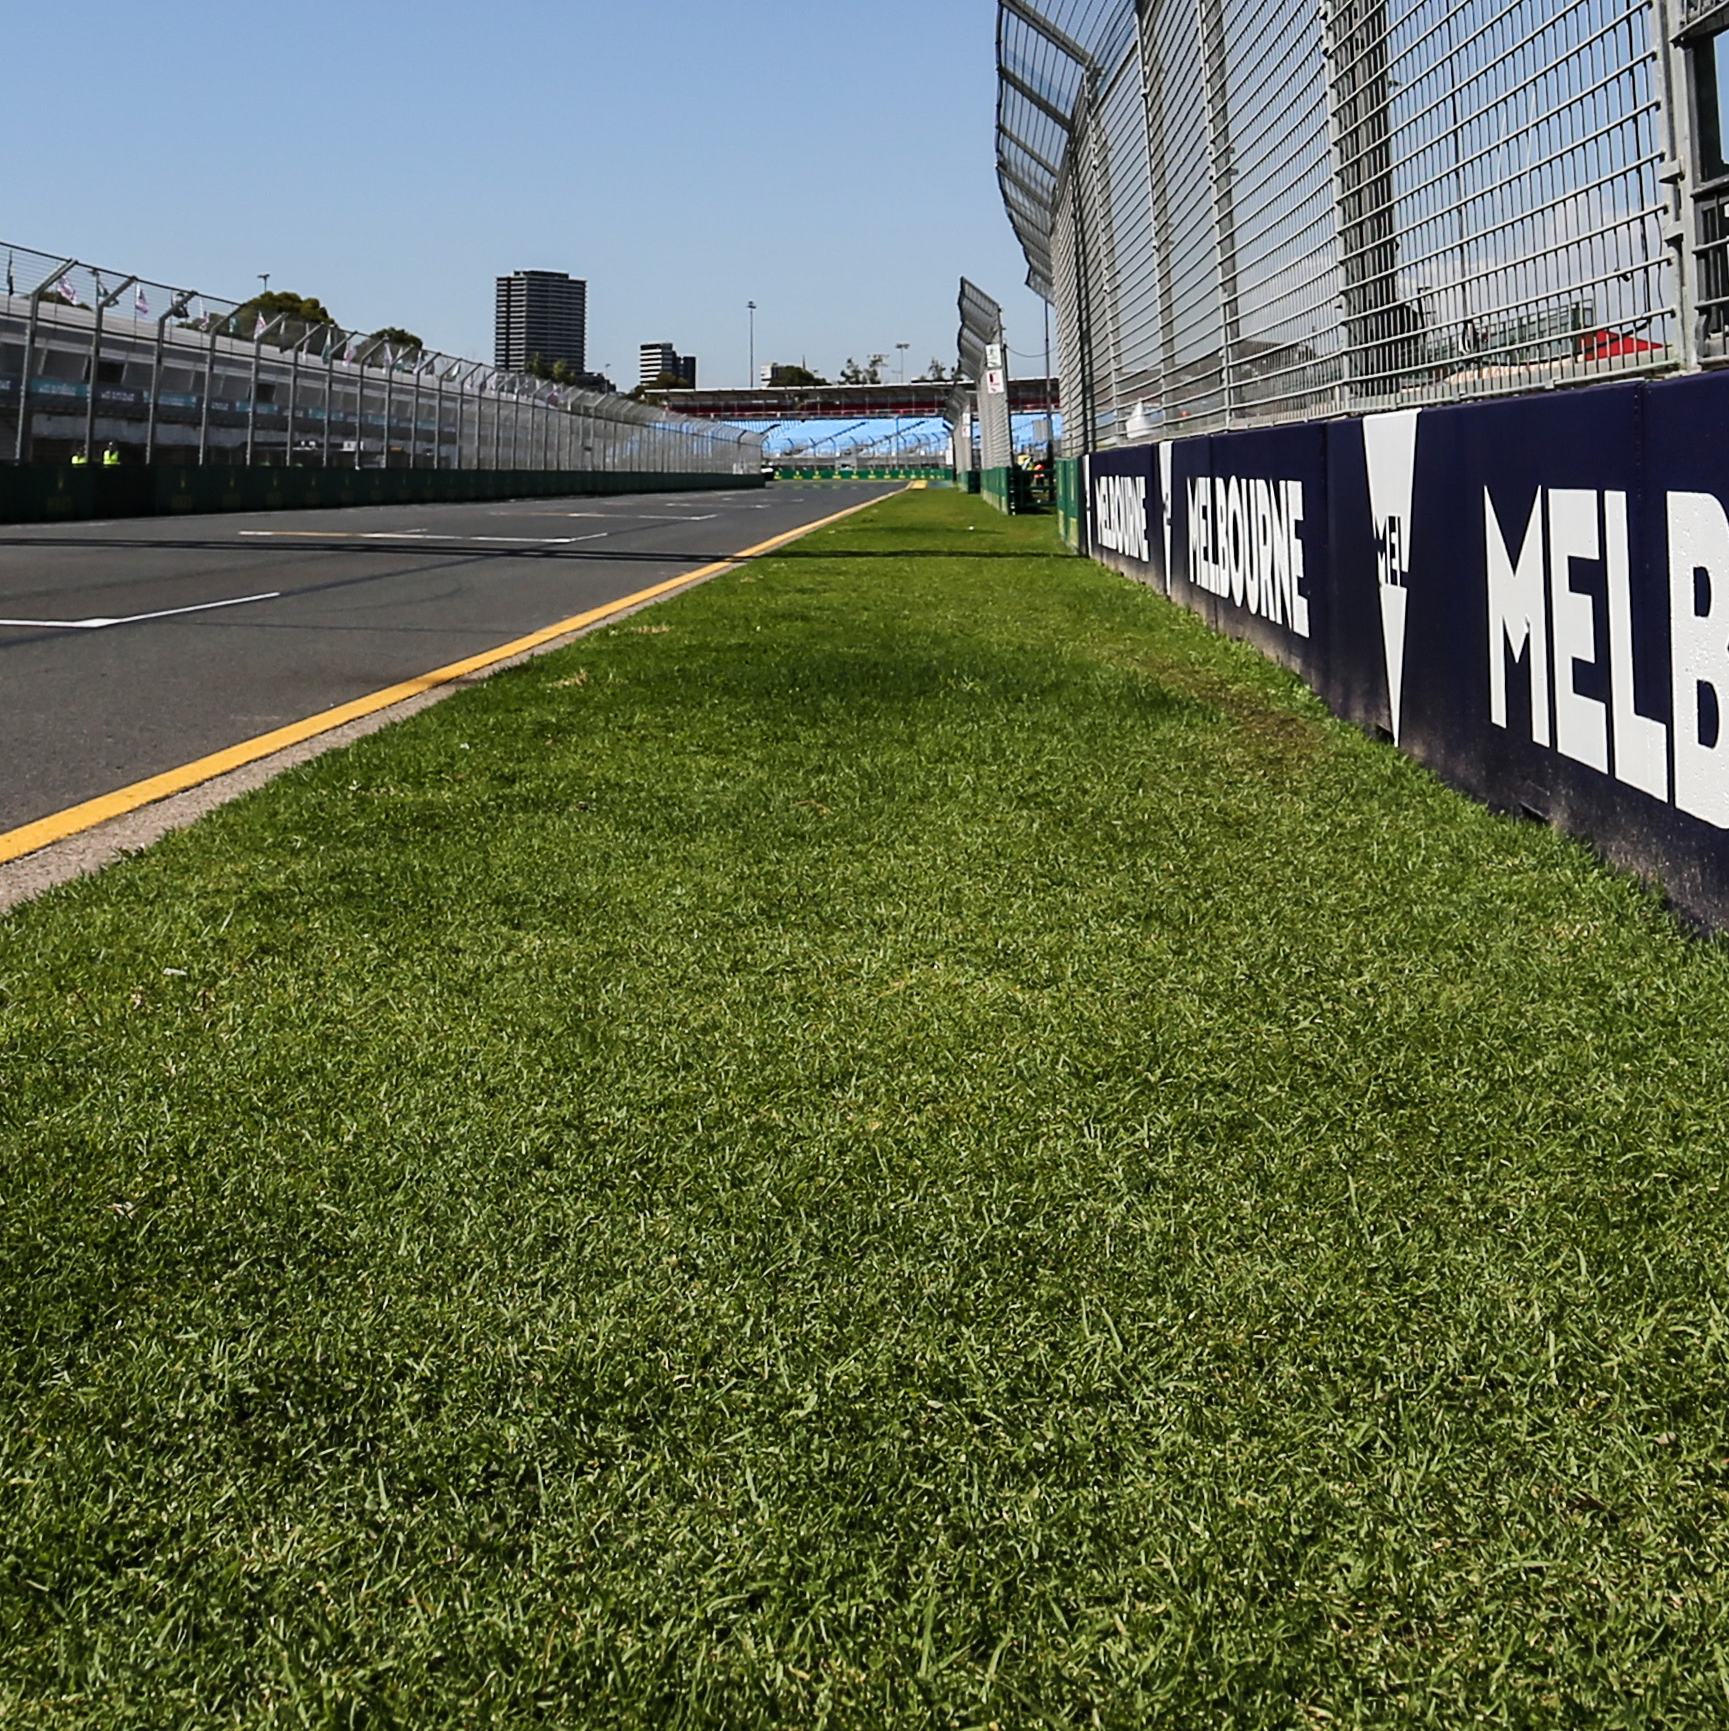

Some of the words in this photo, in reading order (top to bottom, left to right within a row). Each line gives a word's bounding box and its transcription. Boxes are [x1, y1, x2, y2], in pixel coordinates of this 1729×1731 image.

[1095, 474, 1150, 562] MELBOURNE
[1186, 475, 1310, 638] MELBOURNE
[1372, 515, 1410, 587] MEL
